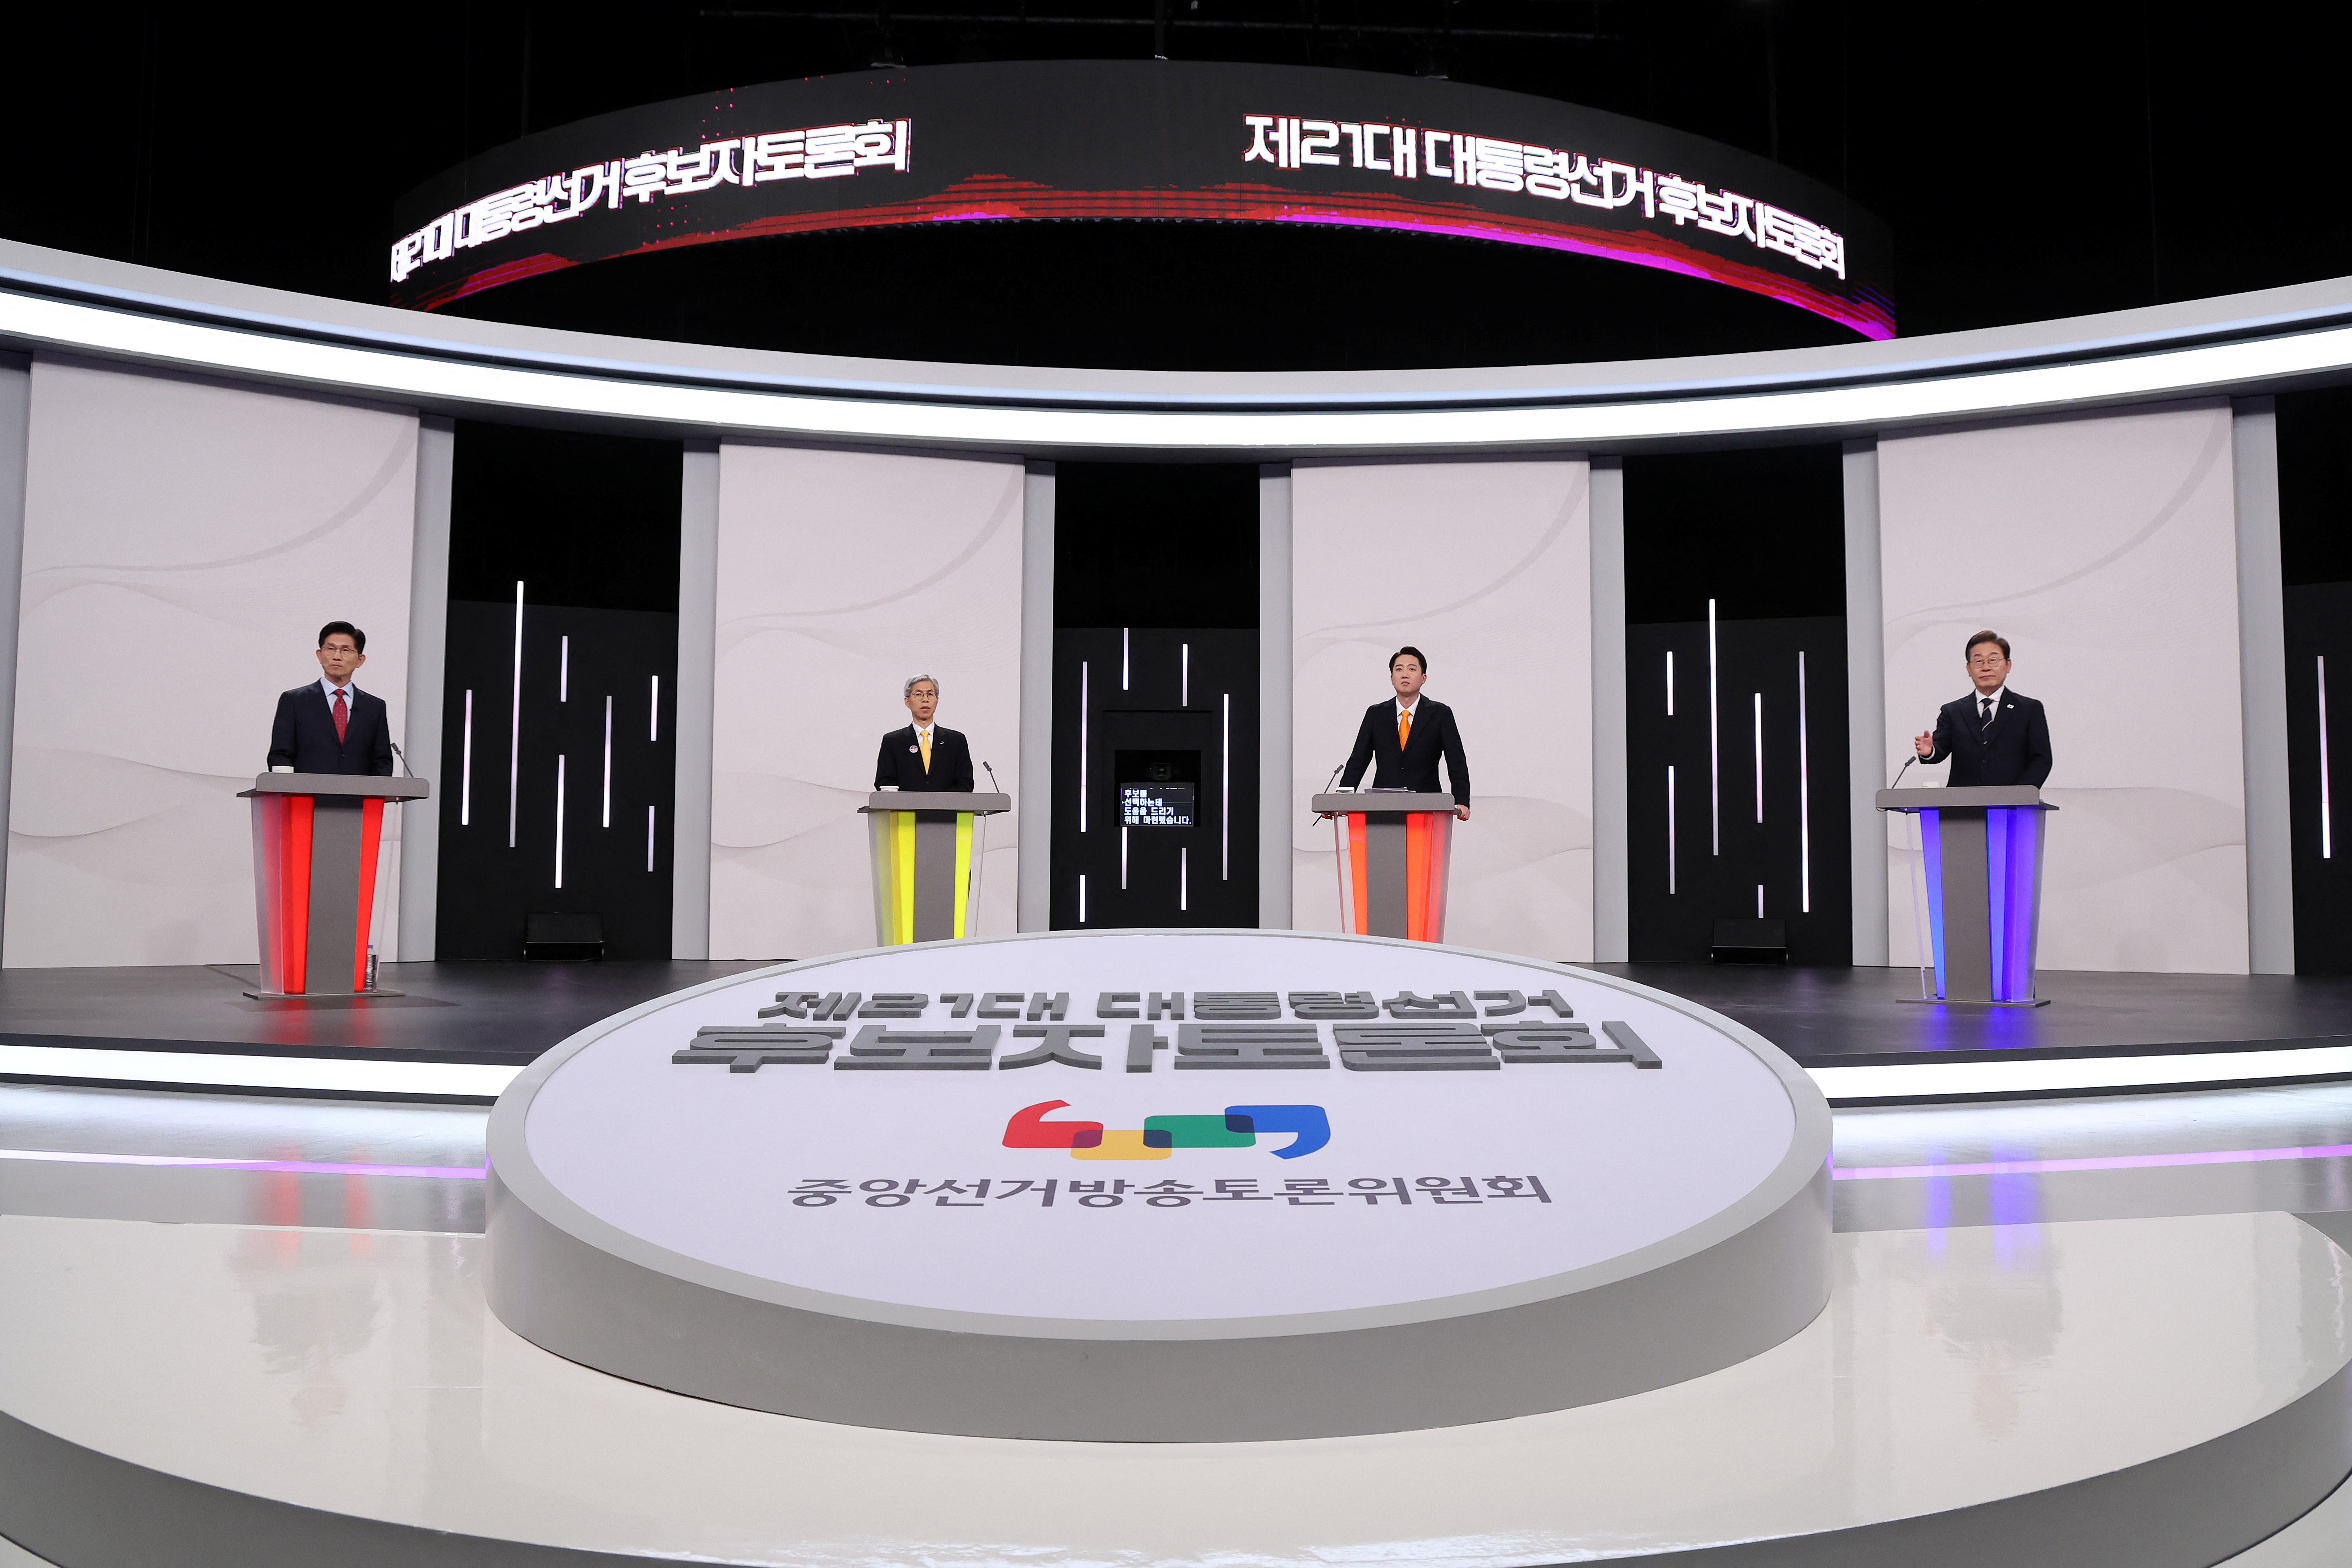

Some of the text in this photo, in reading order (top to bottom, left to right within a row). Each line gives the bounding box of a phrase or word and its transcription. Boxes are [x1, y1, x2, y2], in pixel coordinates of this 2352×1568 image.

[1244, 116, 1416, 178] 제21대
[1124, 789, 1147, 797] 후보를
[1124, 798, 1162, 806] 선택하는데
[1124, 807, 1173, 815] 도움을 드리기
[1124, 816, 1191, 824] 위해 마련됐습니다.
[758, 990, 1573, 1021] 제21대 대통령선거
[672, 1021, 1663, 1073] 후보자토론회
[787, 1176, 1552, 1207] 중앙선거방송토론위원회
